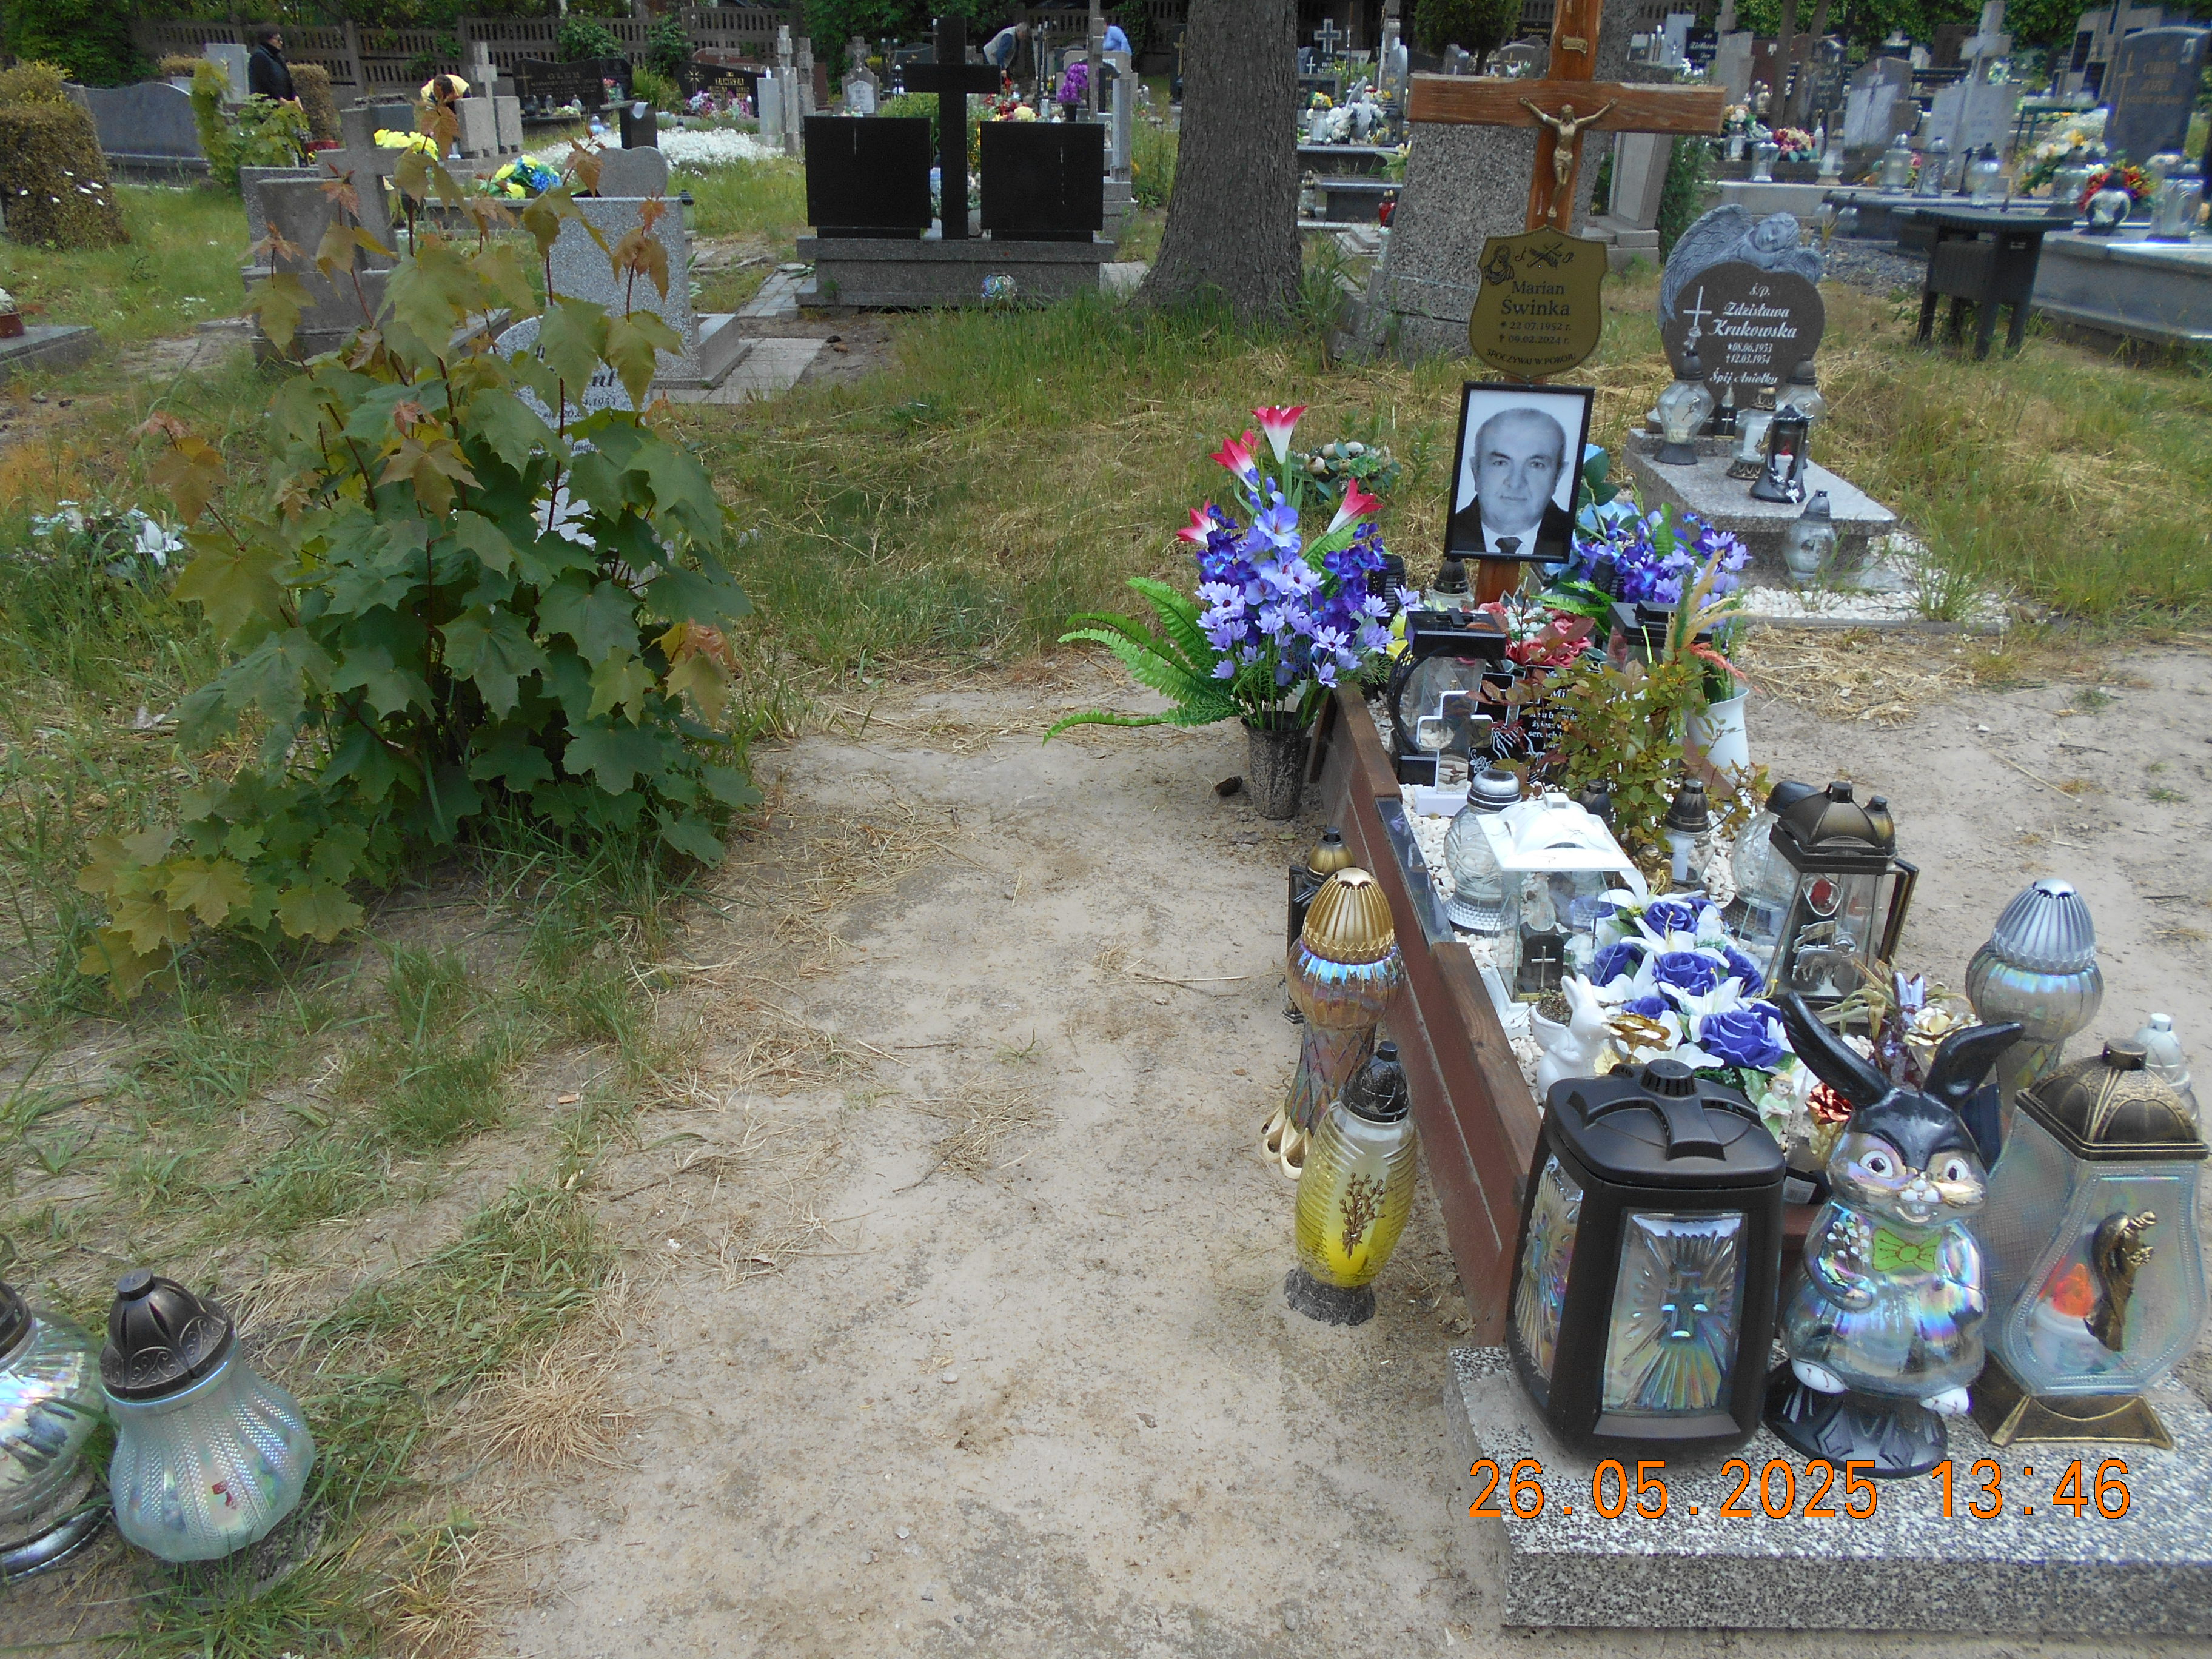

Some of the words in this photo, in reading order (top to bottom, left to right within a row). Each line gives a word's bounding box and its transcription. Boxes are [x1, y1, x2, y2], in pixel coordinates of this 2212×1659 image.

[1512, 281, 1565, 296] Marian
[1501, 295, 1570, 317] Świnka
[1723, 301, 1791, 318] Zdzisława
[1708, 318, 1798, 338] Krukowska
[1710, 367, 1733, 384] Śpij
